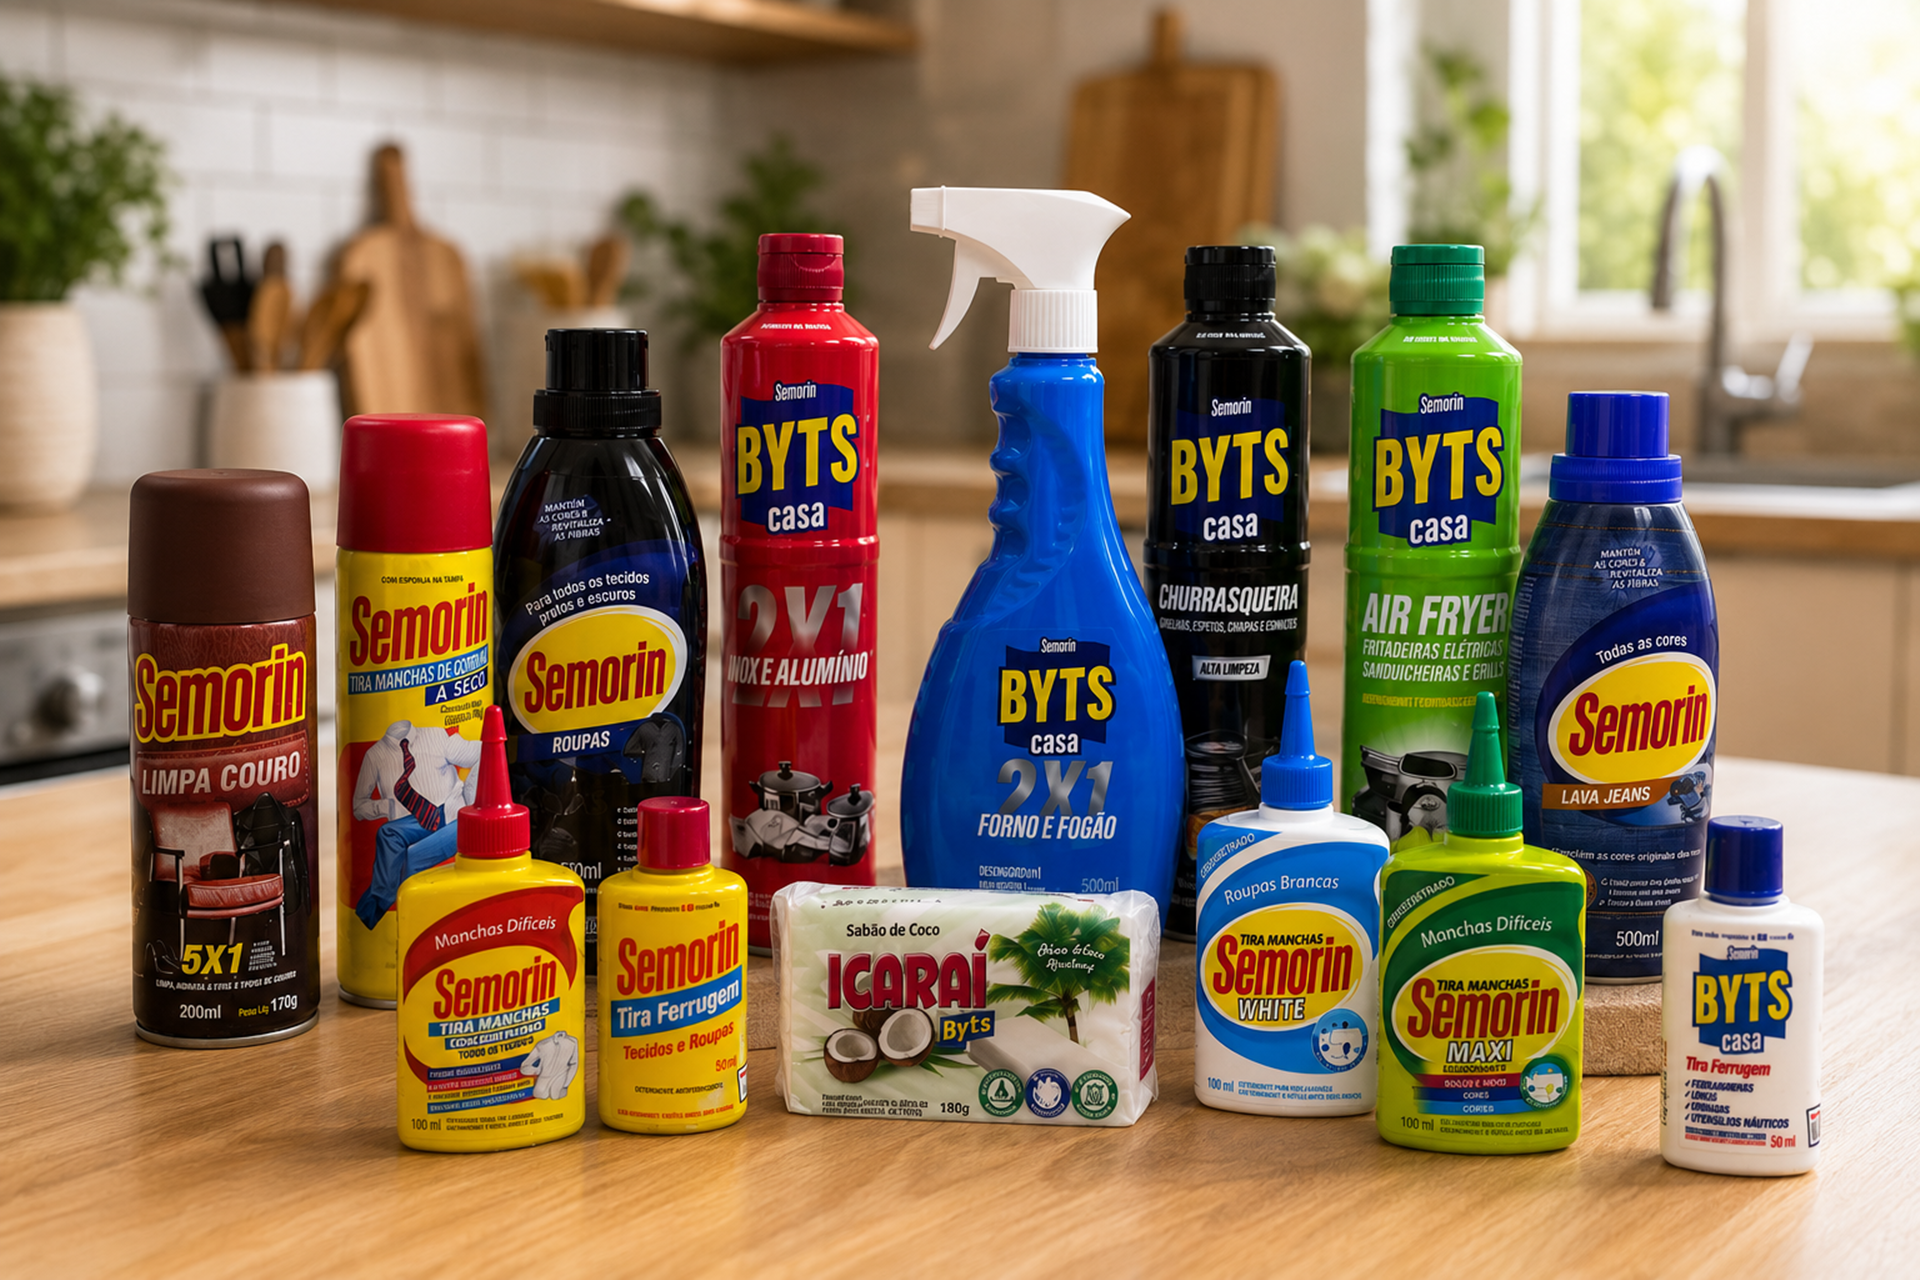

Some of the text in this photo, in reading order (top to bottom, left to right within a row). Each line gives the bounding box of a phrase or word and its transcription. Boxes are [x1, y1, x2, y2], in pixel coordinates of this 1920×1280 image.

[775, 381, 817, 402] Semorin
[1420, 393, 1464, 414] Semorin
[1211, 397, 1252, 417] Semorin
[737, 413, 857, 495] BYTS
[1171, 428, 1289, 506] BYTS
[1375, 426, 1502, 508] BYTS
[768, 502, 825, 532] casa
[1203, 513, 1258, 541] casa
[1410, 515, 1468, 544] casa
[525, 594, 552, 615] Para
[588, 577, 603, 589] os
[605, 571, 650, 585] tecidos
[577, 597, 585, 607] e
[588, 589, 636, 604] escuros
[1159, 584, 1298, 616] CHURRASQUEIRA
[350, 582, 487, 666] Semorin
[1362, 592, 1509, 635] AIR FRYER
[732, 582, 863, 708] 2X1
[1041, 638, 1076, 654] Semorin
[1363, 639, 1504, 660] FRITADEIRAS ELÉTRICAS
[1595, 634, 1687, 664] Todas as cores
[351, 663, 451, 692] TIRA MANCHAS DE
[524, 641, 666, 714] Semorin
[727, 649, 868, 686] INOX E ALUMÍNIO
[1200, 662, 1260, 675] ALTA LIMPEZA
[1362, 661, 1504, 682] SANDUICHEIRAS E GRILLS
[135, 643, 306, 743] Semorin
[435, 671, 485, 702] A SECO
[1000, 665, 1113, 723] BYTS
[1568, 685, 1707, 757] Semorin
[552, 730, 610, 754] ROUPAS
[1031, 733, 1079, 754] casa
[142, 751, 300, 795] LIMPA COURO
[997, 758, 1113, 817] 2X1
[1561, 786, 1650, 805] LAVA JEANS
[977, 812, 1117, 840] FORNO E FOGÃO
[1610, 852, 1636, 861] cores
[1081, 877, 1119, 893] 500ml
[1224, 875, 1339, 905] Roupas Brancas
[434, 923, 503, 950] Manchas
[846, 922, 940, 937] Sabão de Coco
[1240, 933, 1323, 946] TIRA MANCHAS
[1421, 919, 1492, 948] Manchas
[1616, 930, 1659, 947] 500ml
[181, 942, 243, 975] 5X1
[617, 919, 740, 996] Semorin
[828, 928, 991, 1010] ICARAÍ
[1213, 934, 1353, 996] Semorin
[434, 955, 557, 1020] Semorin
[1436, 978, 1529, 992] TIRA MANCHAS
[1695, 970, 1790, 1024] BYTS
[180, 1004, 222, 1019] 200ml
[271, 995, 298, 1012] 170g
[617, 979, 740, 1030] Tira Ferrugem
[1238, 997, 1305, 1021] WHITE
[1407, 978, 1560, 1039] Semorin
[440, 1022, 474, 1036] TIRA
[479, 1003, 550, 1031] MANCHAS
[943, 1014, 991, 1042] Byts
[623, 1021, 734, 1060] Tecidos e Roupas
[1446, 1039, 1513, 1064] MAXI
[1722, 1033, 1761, 1052] casa
[1686, 1056, 1771, 1079] Tira Ferrugem
[1207, 1077, 1234, 1092] 100 ml
[940, 1102, 970, 1116] 180g
[1743, 1116, 1790, 1129] NÁUTICOS
[411, 1118, 428, 1131] 100
[430, 1119, 442, 1131] ml
[1401, 1116, 1420, 1130] 100
[1422, 1119, 1435, 1131] ml
[1784, 1135, 1796, 1148] ml
